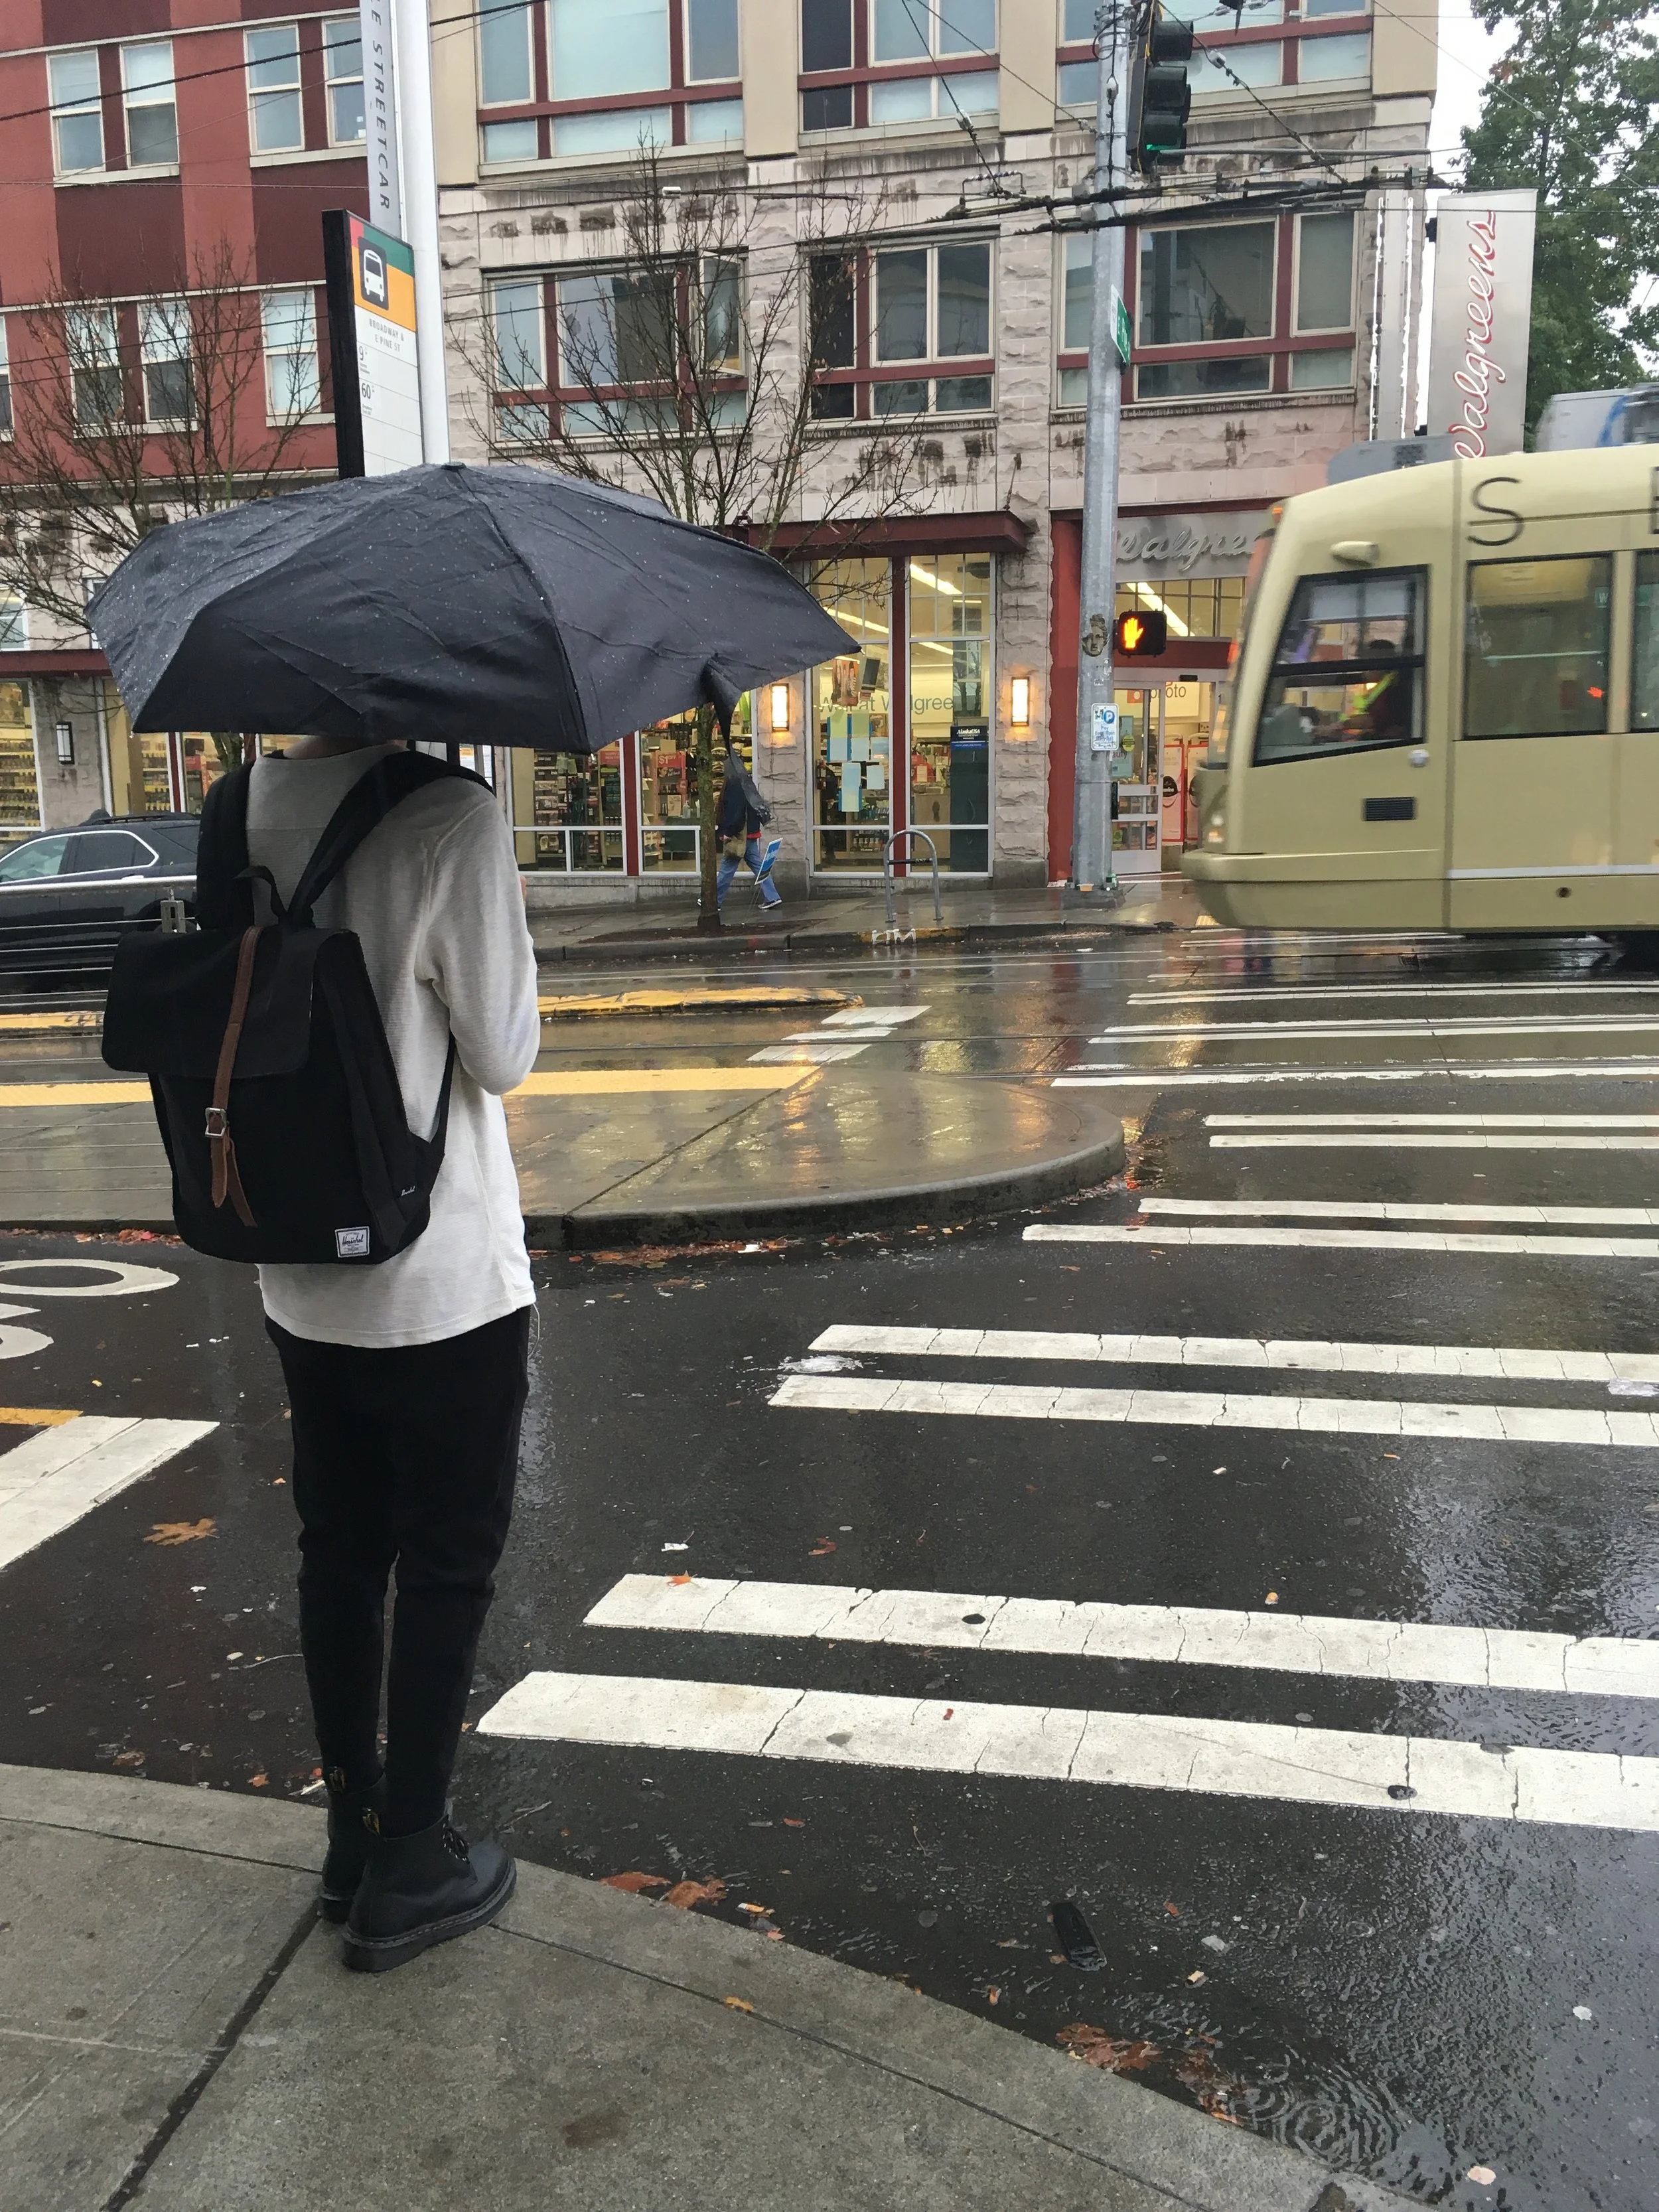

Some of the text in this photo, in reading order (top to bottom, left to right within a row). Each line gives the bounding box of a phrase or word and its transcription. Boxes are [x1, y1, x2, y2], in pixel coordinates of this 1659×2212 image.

[370, 0, 390, 210] E STREETCAR
[369, 319, 399, 339] BROADWAY
[375, 334, 401, 352] E PINE ST
[358, 346, 364, 361] 9
[361, 383, 371, 400] 60
[1149, 684, 1187, 701] poto
